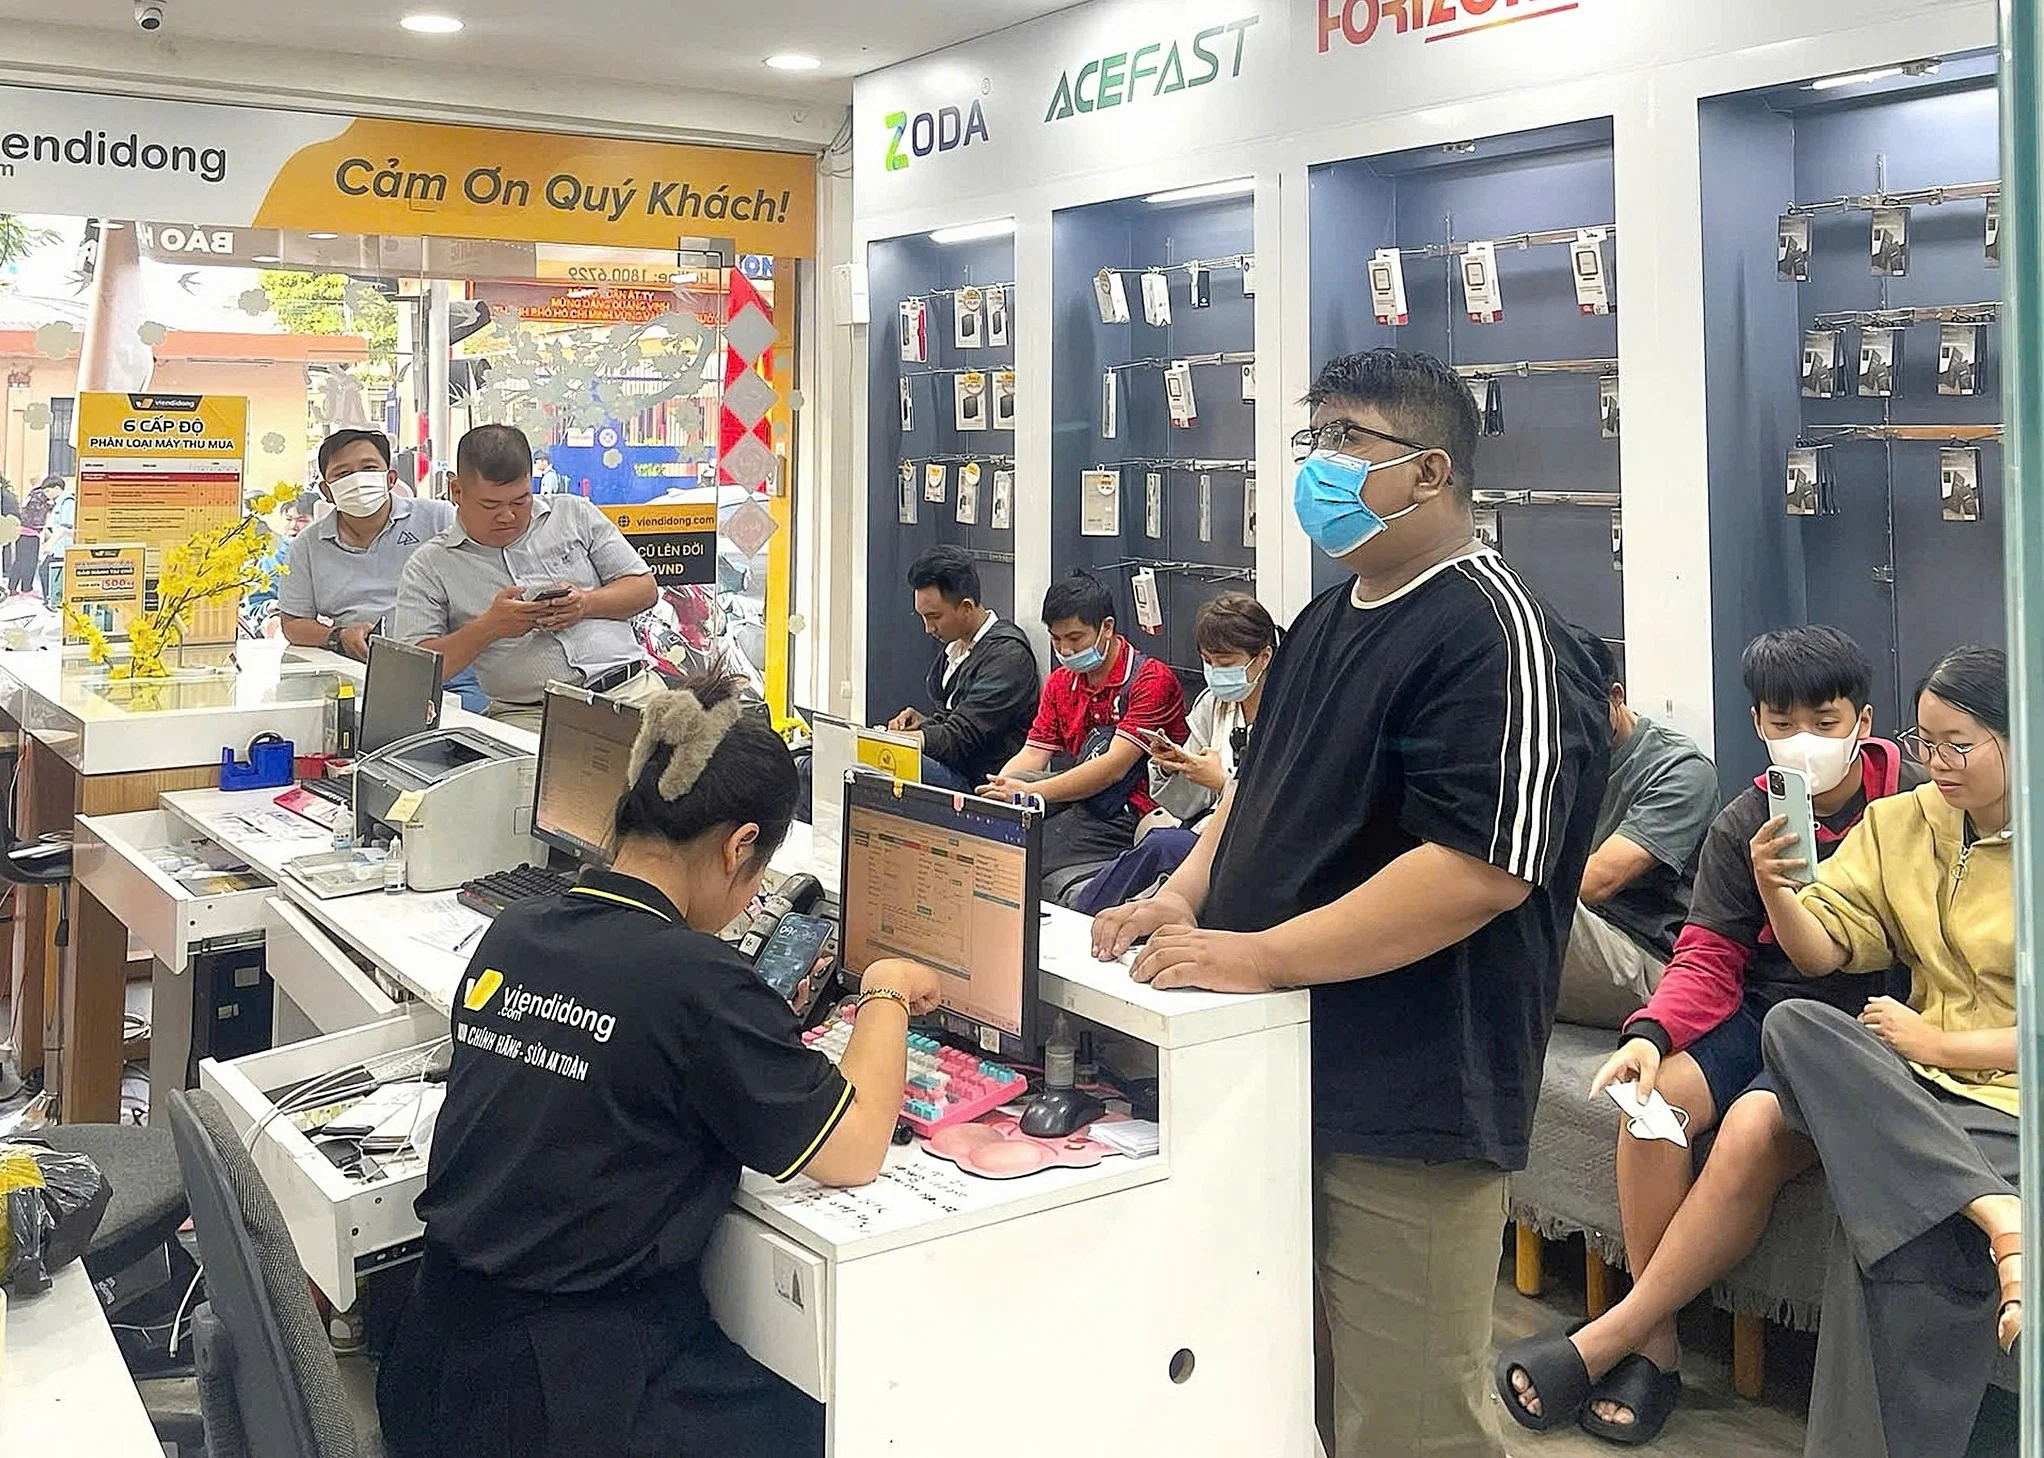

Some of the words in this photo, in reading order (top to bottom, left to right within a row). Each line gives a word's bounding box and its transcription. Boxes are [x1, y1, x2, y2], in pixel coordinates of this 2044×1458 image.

[1043, 15, 1261, 123] ACEFAST
[2, 130, 226, 183] endidong
[885, 99, 989, 172] ZODA
[335, 157, 447, 201] Cảm
[463, 166, 529, 206] Ơn
[545, 173, 636, 222] Quý
[647, 180, 790, 224] Khách!
[90, 437, 123, 448] PHÂN
[126, 439, 152, 449] LOẠI
[155, 437, 180, 449] MÁY
[183, 439, 205, 449] THU
[207, 440, 234, 450] MUA
[123, 420, 136, 432] 6
[140, 415, 175, 433] CẤP
[179, 418, 204, 436] ĐỘ
[636, 515, 715, 527] viendidong.com
[657, 542, 680, 557] LÊN
[682, 541, 704, 556] ĐỜI
[497, 1006, 522, 1022] .com
[504, 984, 616, 1042] viendidong
[467, 1026, 497, 1051] CHÍNH
[545, 1050, 561, 1072] AN
[557, 1054, 589, 1081] TOÀN
